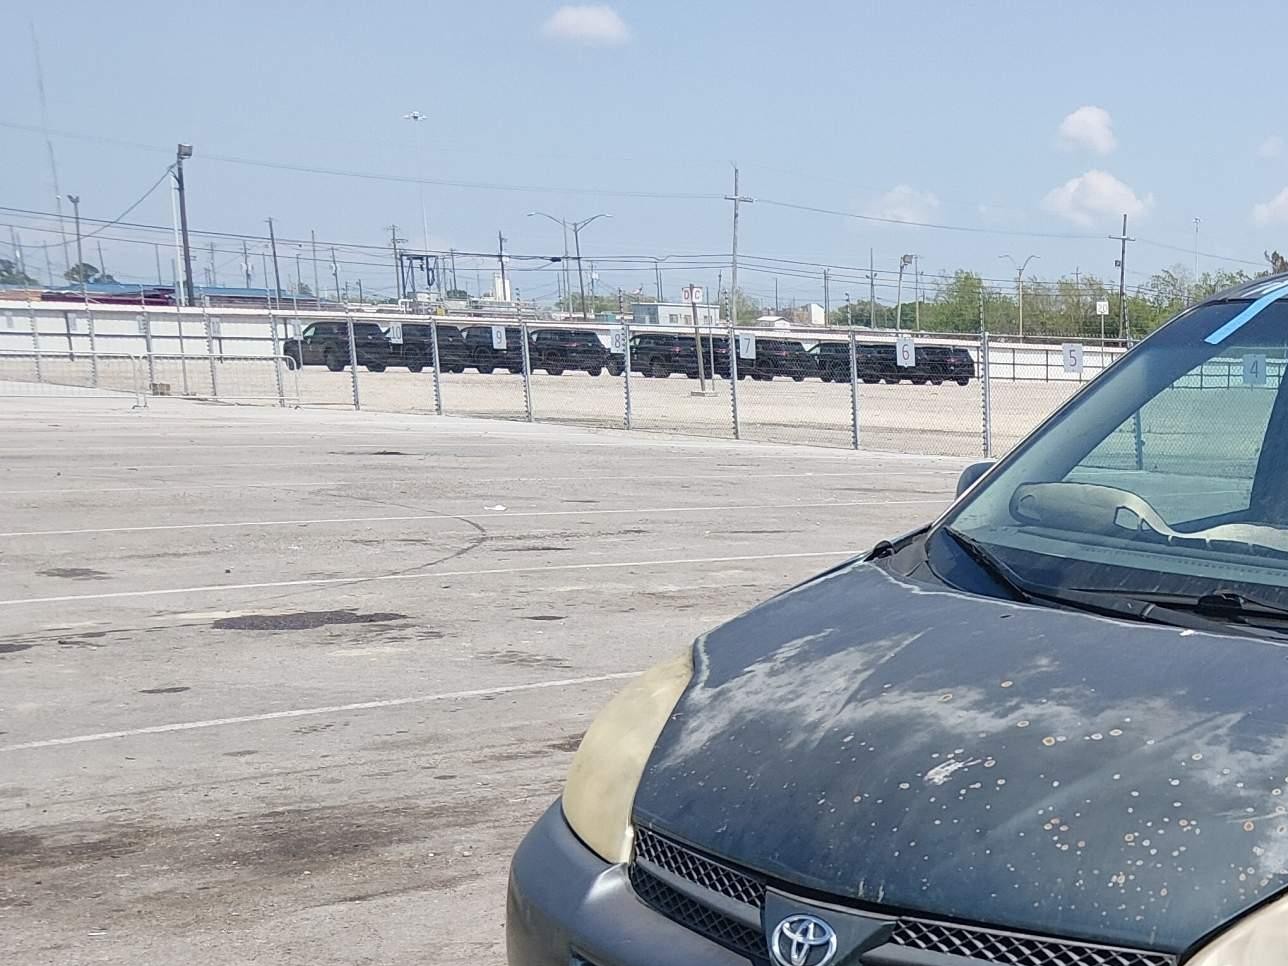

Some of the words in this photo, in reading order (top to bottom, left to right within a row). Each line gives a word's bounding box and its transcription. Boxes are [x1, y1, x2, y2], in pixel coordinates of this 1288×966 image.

[496, 329, 503, 344] 9
[614, 333, 621, 349] 8
[743, 337, 751, 353] 7
[901, 343, 910, 361] 6
[1069, 349, 1077, 367] 5
[1250, 360, 1259, 379] 4
